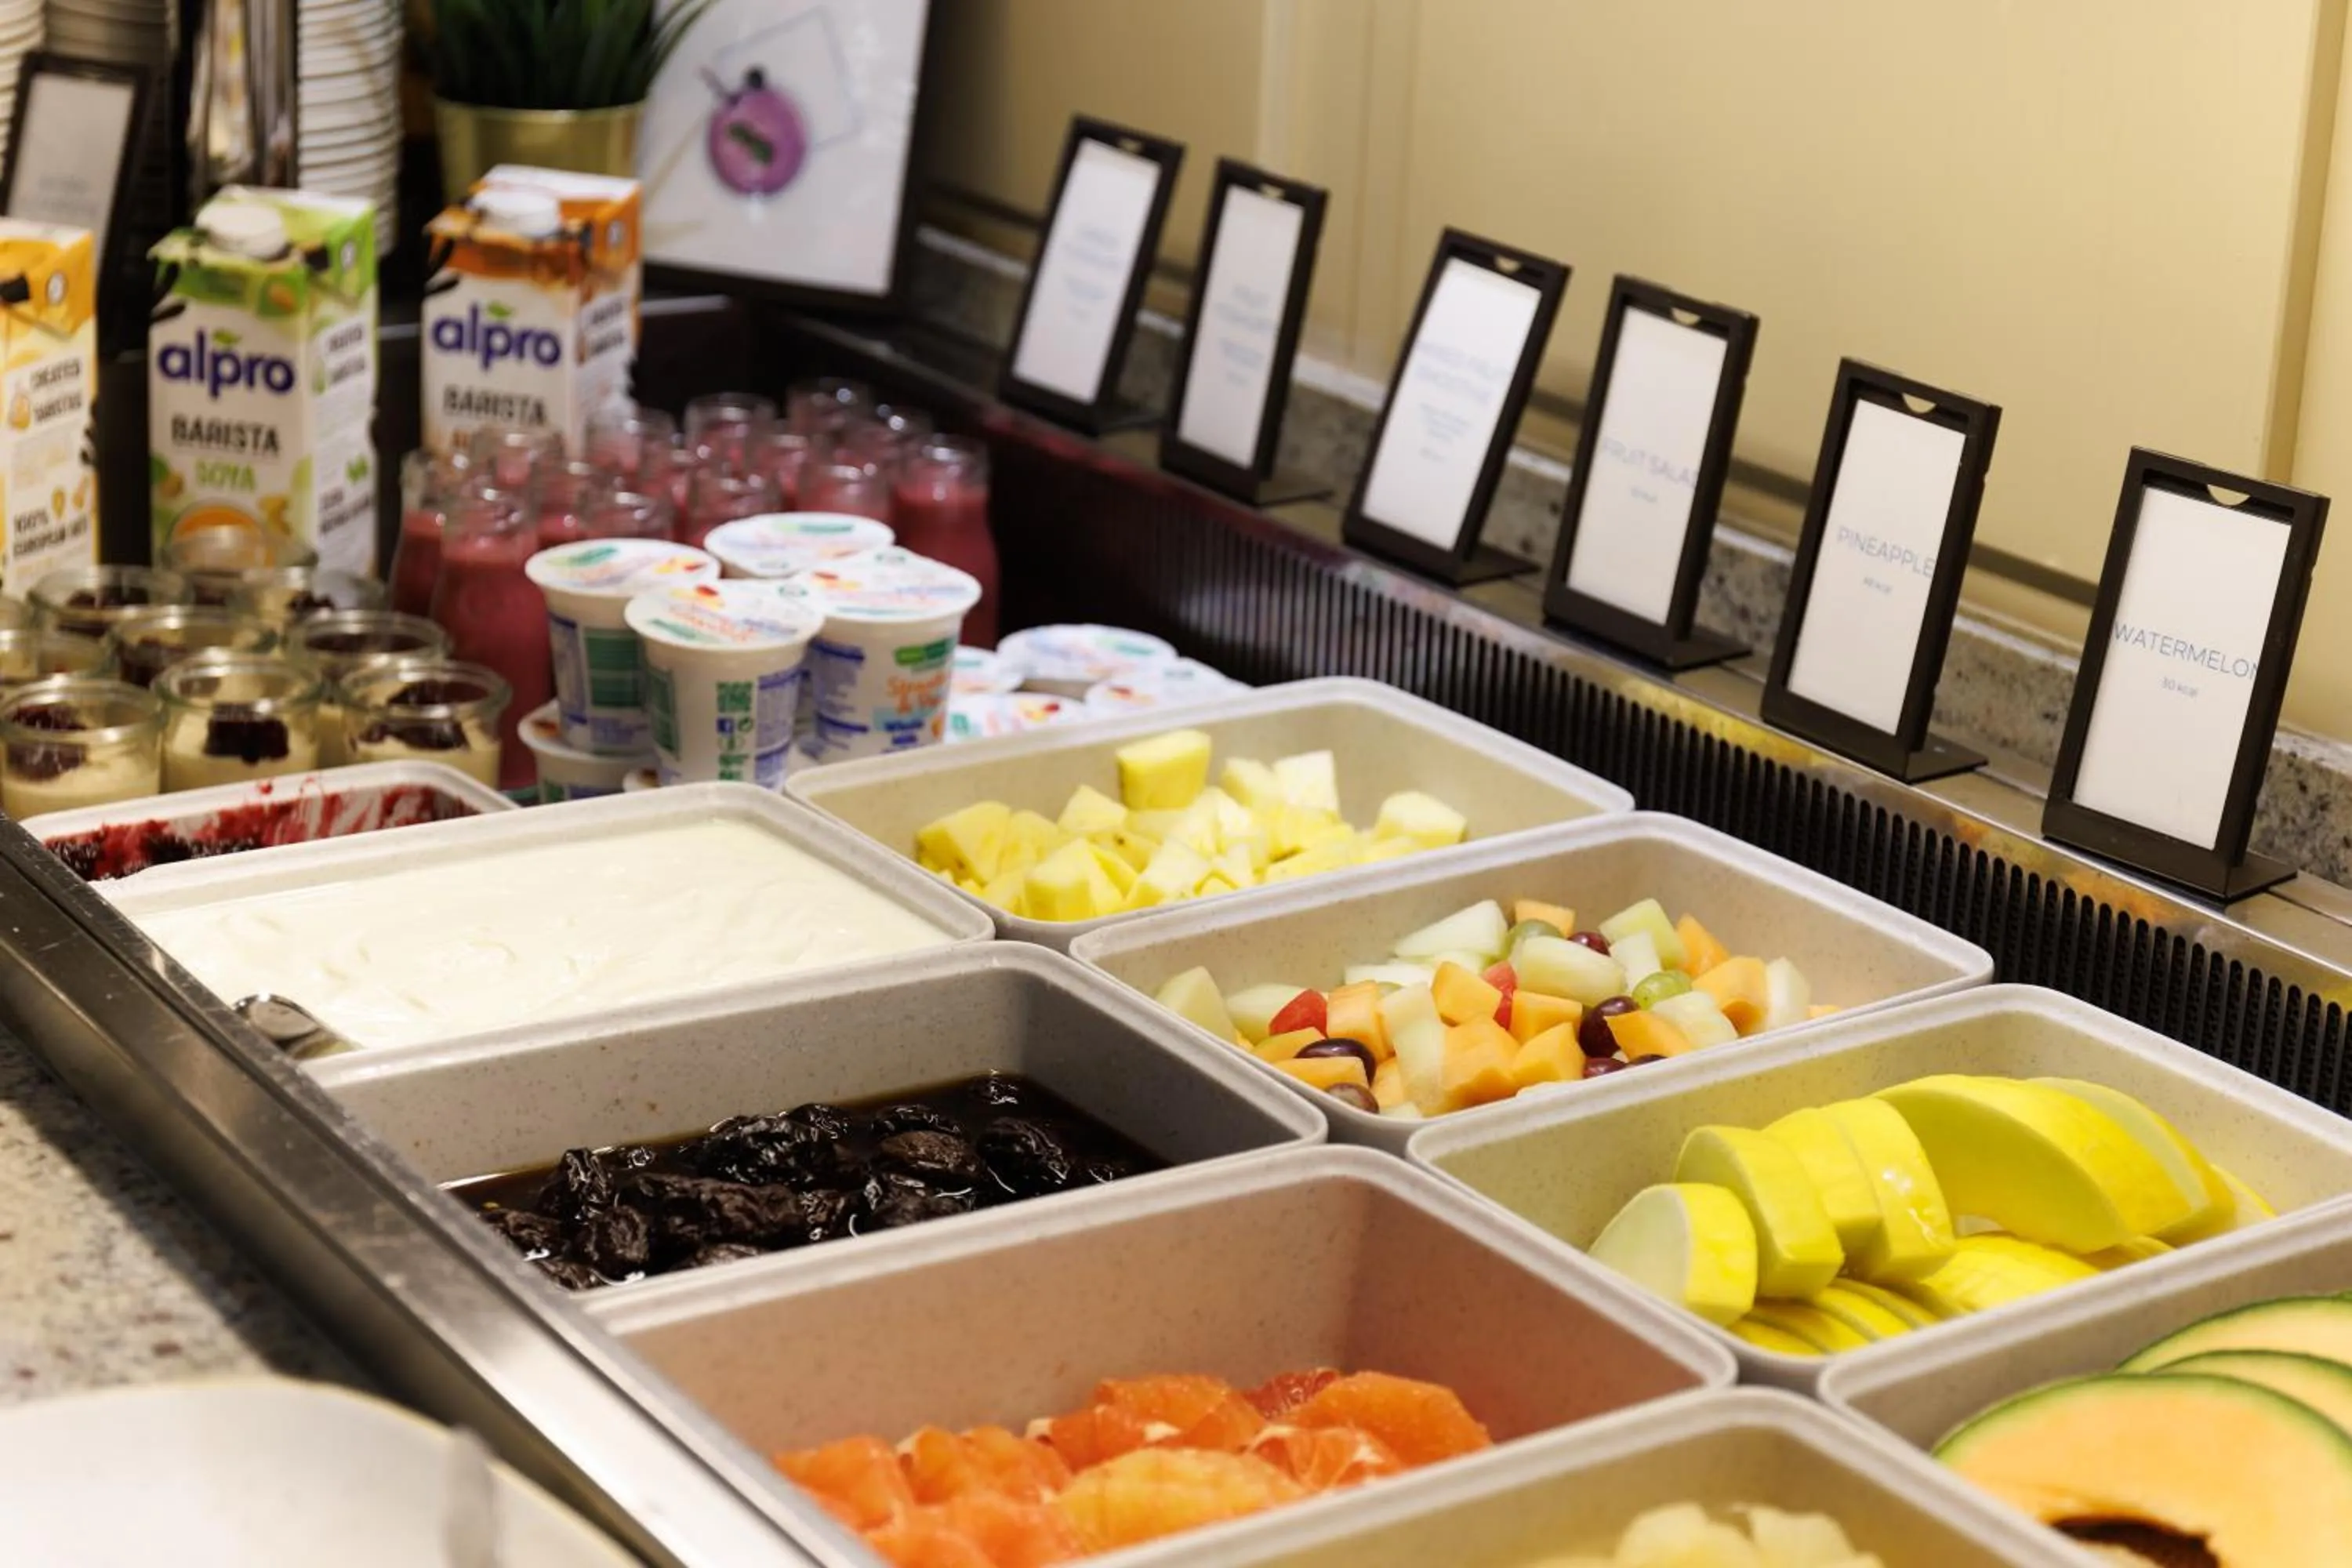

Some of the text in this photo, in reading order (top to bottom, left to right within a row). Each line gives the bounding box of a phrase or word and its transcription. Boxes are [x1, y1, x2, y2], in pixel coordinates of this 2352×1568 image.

[433, 303, 561, 370] alpro
[158, 328, 294, 399] alpro
[444, 387, 546, 425] BARISTA
[172, 415, 279, 454] BARISTA
[196, 460, 255, 492] SOYA
[1838, 525, 1936, 579] PINEAPPLE
